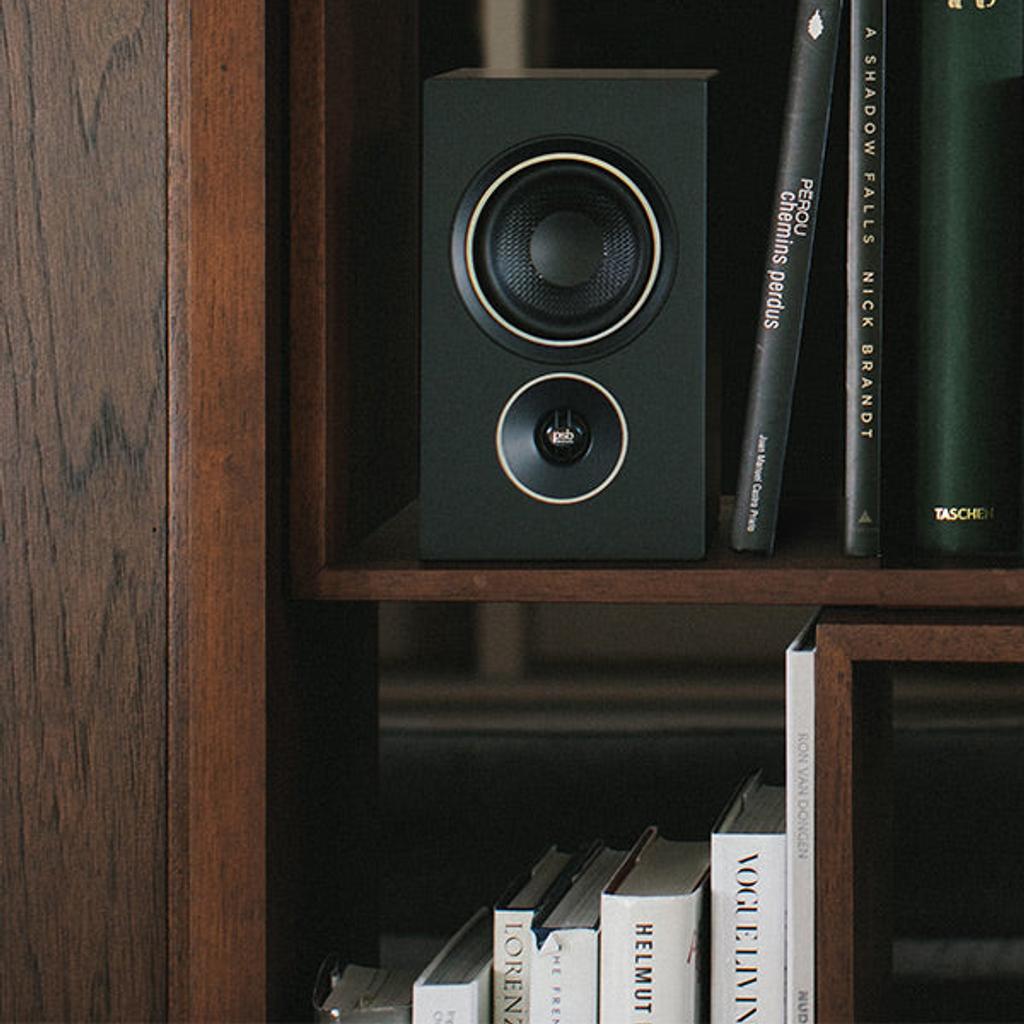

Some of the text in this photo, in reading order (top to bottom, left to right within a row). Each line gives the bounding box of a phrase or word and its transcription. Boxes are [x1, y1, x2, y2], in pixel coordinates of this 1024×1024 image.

[793, 177, 814, 238] PEROU
[860, 26, 877, 439] A SHADOW FALLS NICK BRANDT
[763, 190, 798, 330] chemins perdus
[934, 507, 995, 521] TASCHEN
[797, 733, 809, 859] RON VAN DONGEN
[736, 852, 759, 941] VOGUE
[634, 923, 654, 1013] HELMUT
